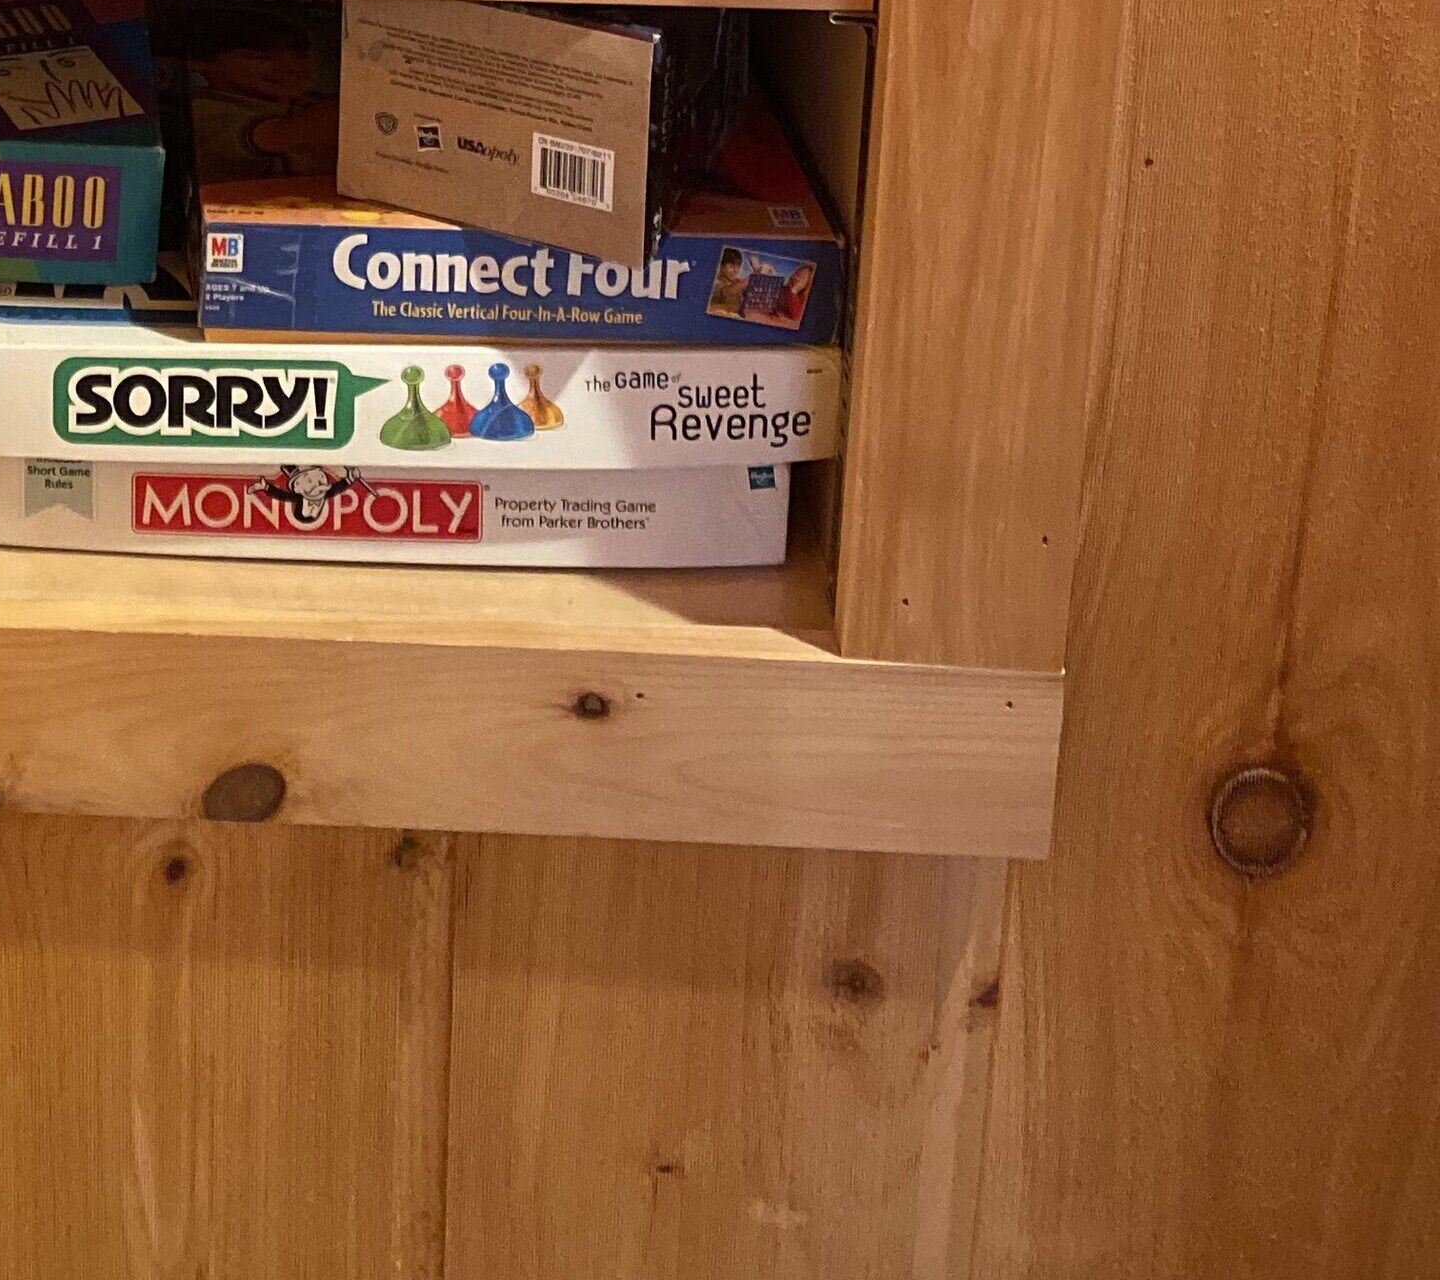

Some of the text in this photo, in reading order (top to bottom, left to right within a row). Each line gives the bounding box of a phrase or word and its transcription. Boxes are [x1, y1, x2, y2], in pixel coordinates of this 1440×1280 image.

[92, 235, 102, 250] 1
[332, 234, 554, 298] Connect
[371, 301, 644, 325] The Classic Vertical Four-In-A-Row Game
[74, 374, 329, 431] SORRY!
[678, 373, 766, 410] sweet
[650, 404, 811, 448] Revenge
[27, 465, 91, 478] Short Game
[44, 478, 74, 491] Rules
[142, 481, 474, 536] MONOPOLY
[494, 497, 656, 515] Property Trading Game
[501, 515, 646, 530] from Parker Brothers
